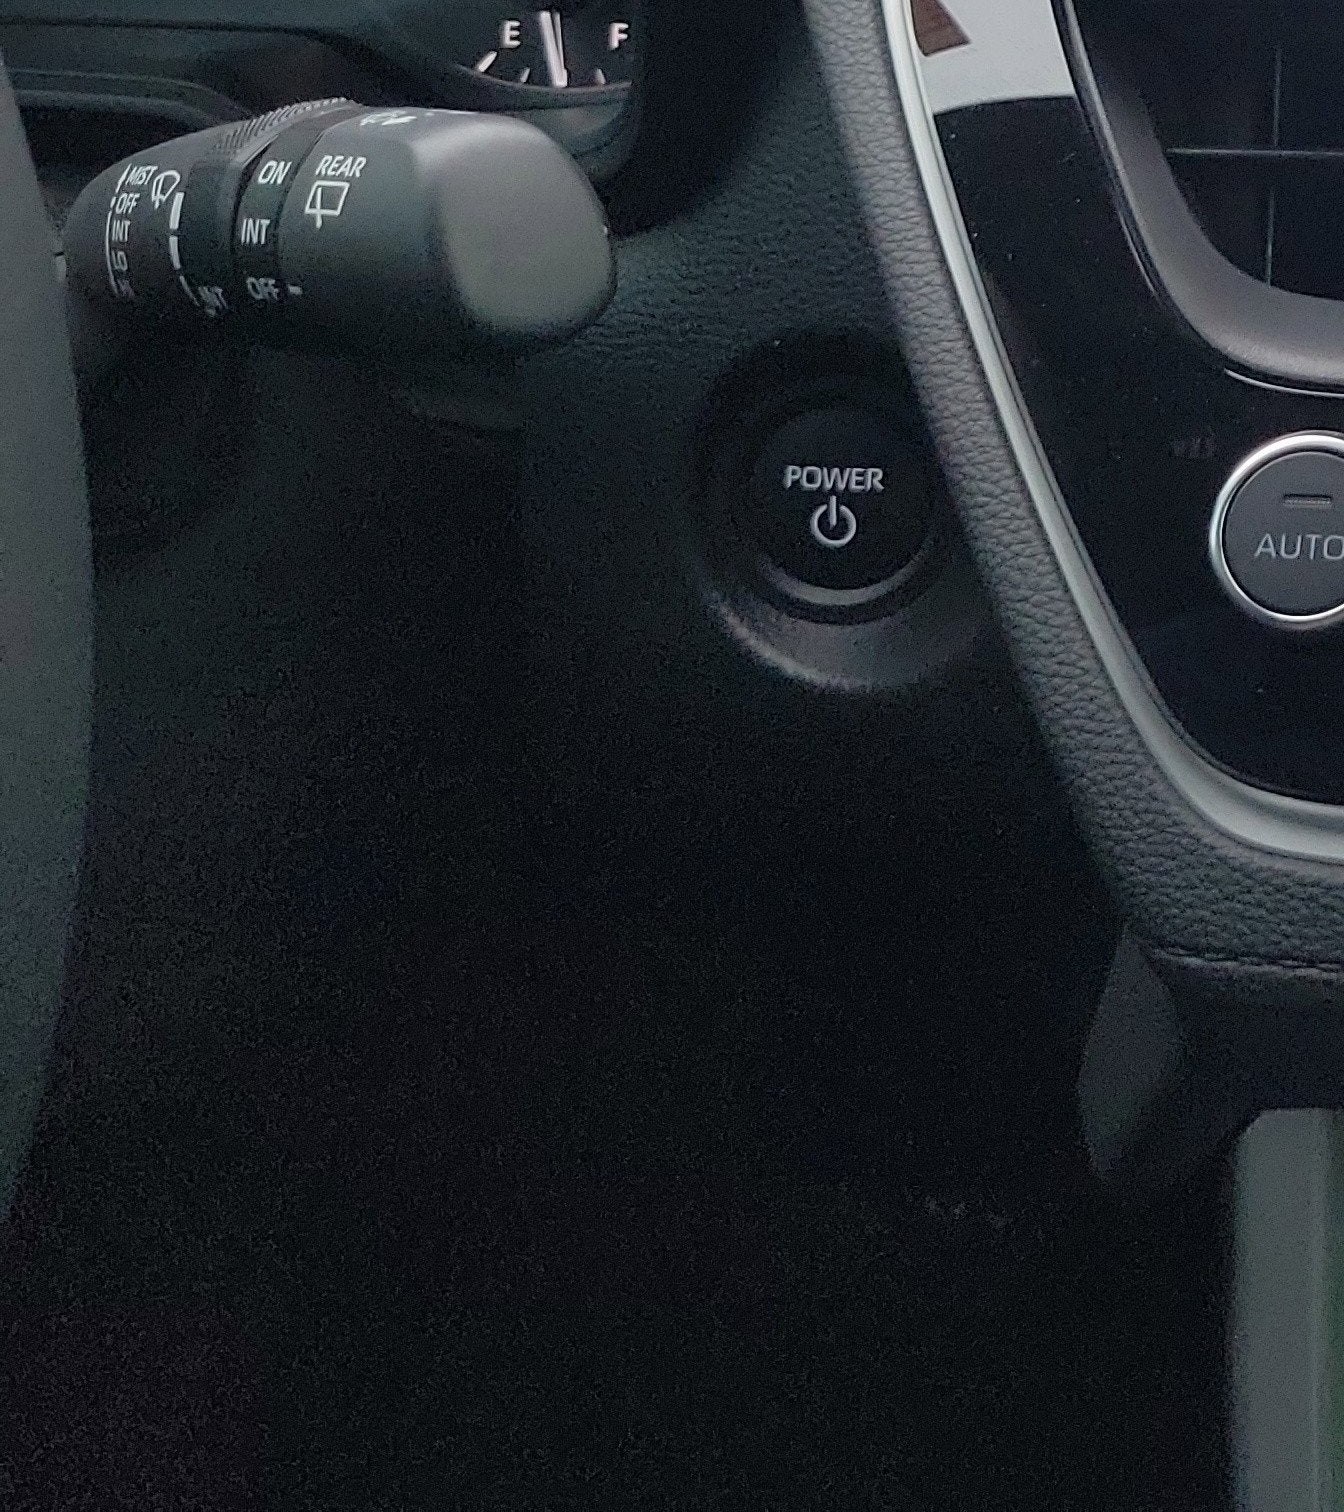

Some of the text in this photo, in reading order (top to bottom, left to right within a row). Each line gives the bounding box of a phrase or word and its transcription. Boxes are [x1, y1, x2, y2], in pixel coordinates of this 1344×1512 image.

[502, 19, 521, 48] E
[608, 22, 629, 50] F
[125, 165, 158, 186] MIST
[257, 160, 293, 185] ON
[315, 154, 367, 178] REAR
[115, 192, 141, 214] OFF
[112, 219, 131, 243] INT
[241, 218, 271, 245] INT
[782, 464, 885, 492] POWER
